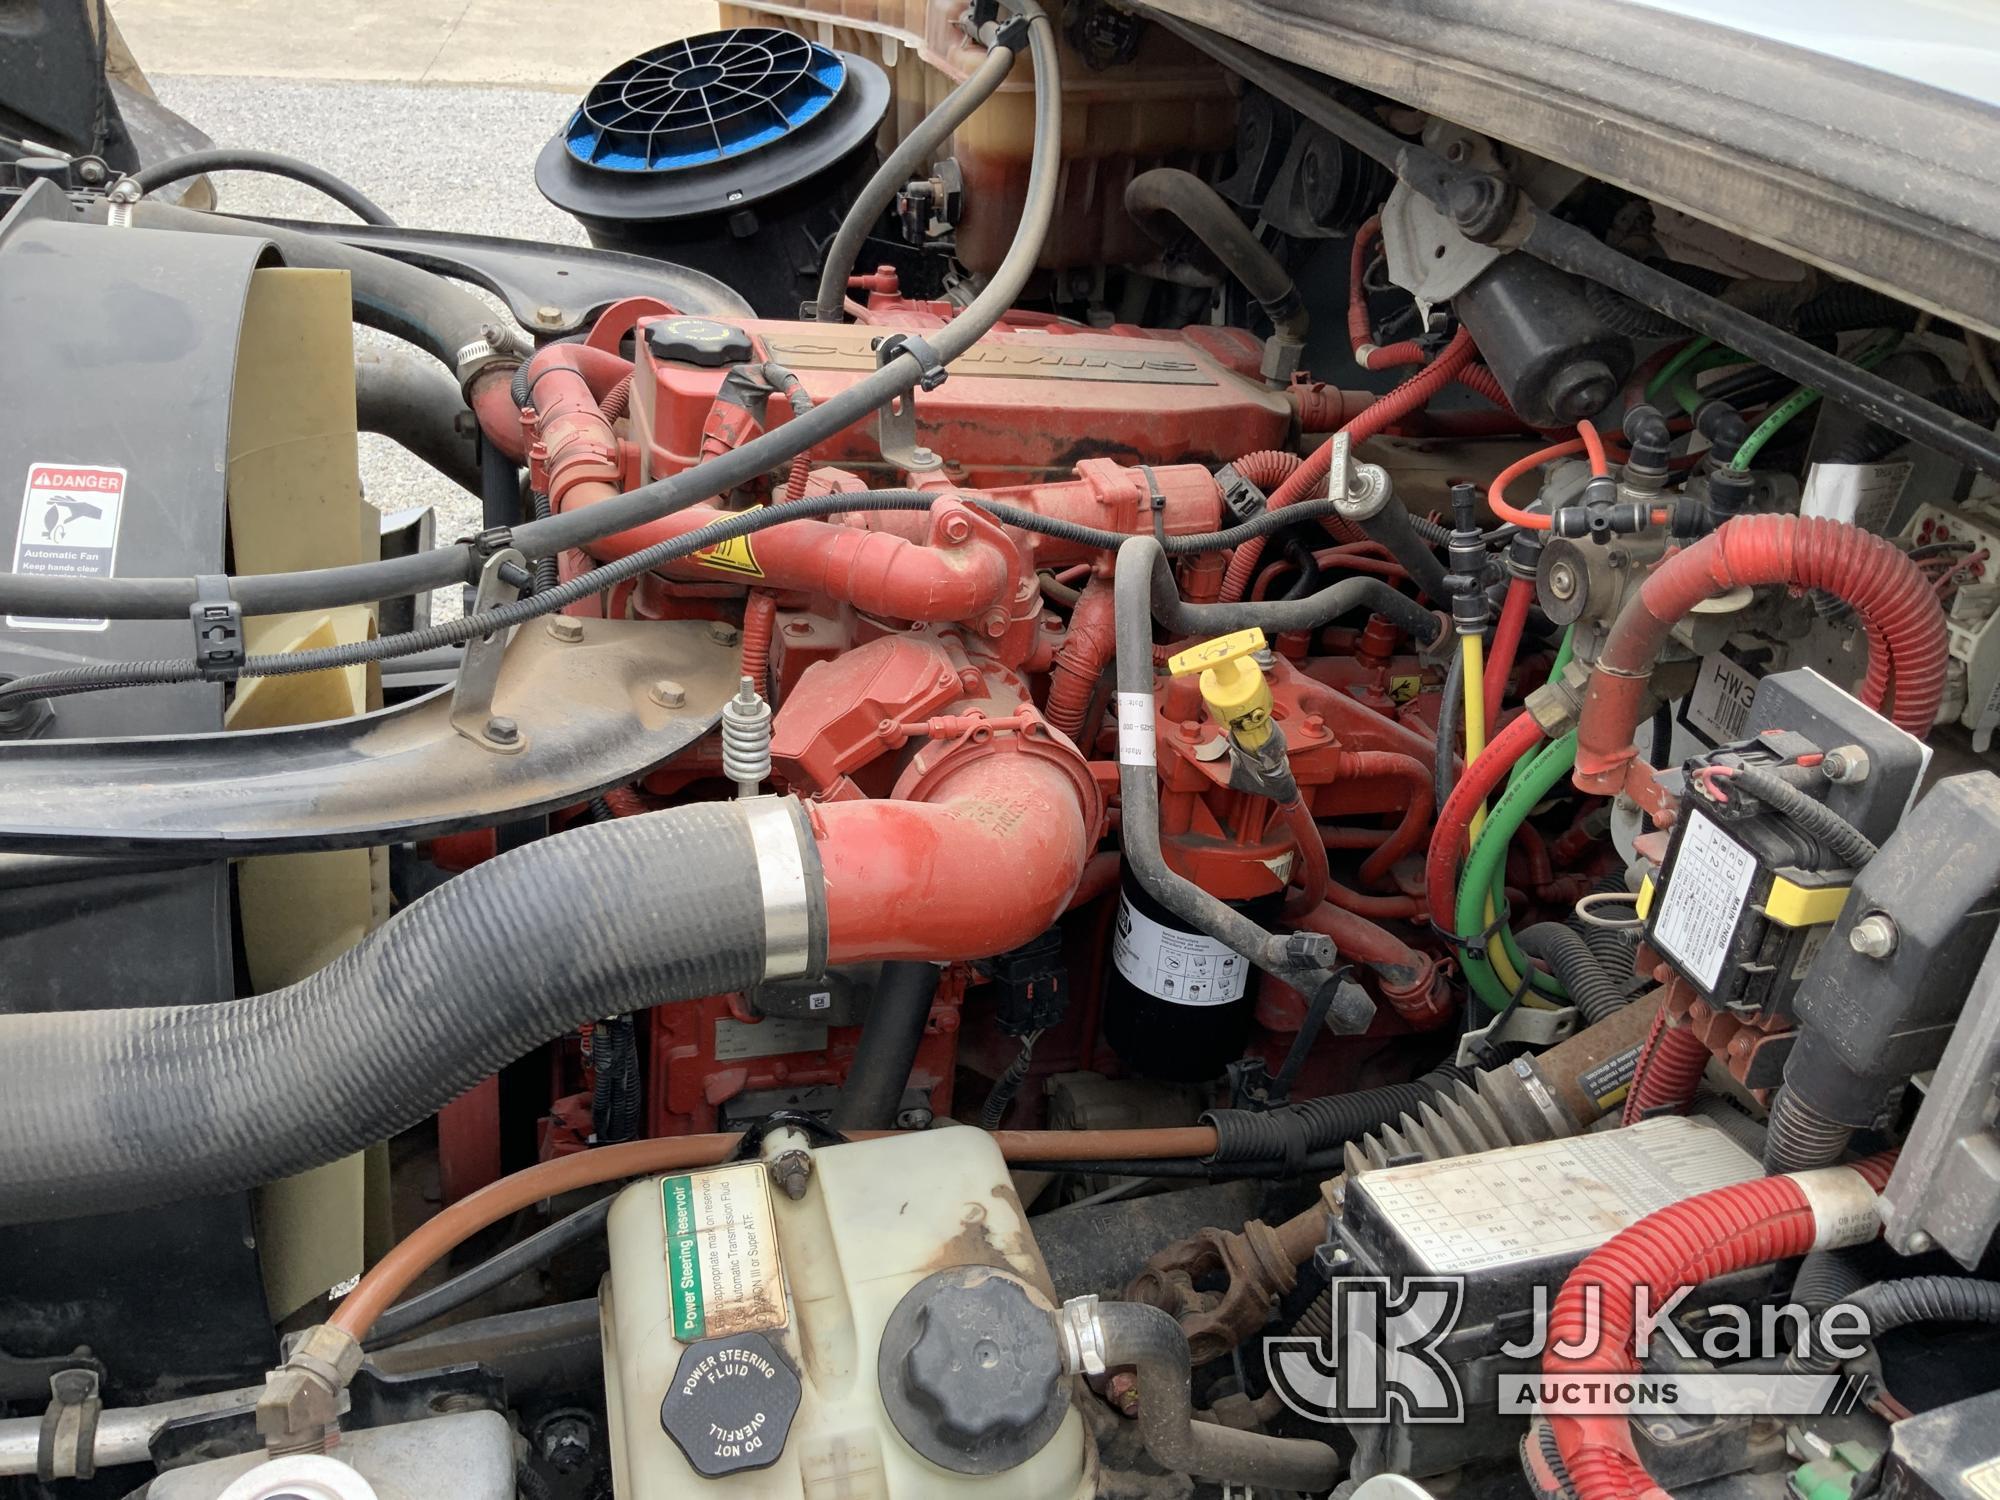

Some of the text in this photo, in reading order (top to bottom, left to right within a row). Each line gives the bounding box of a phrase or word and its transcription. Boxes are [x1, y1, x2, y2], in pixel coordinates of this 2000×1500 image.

[772, 344, 1198, 372] CUMINS
[52, 474, 120, 490] DANGER
[24, 550, 99, 561] Automatic Fan
[22, 562, 99, 573] Keep hands clear
[1710, 856, 1719, 868] 2
[1726, 870, 1735, 881] 3
[1720, 896, 1740, 949] MAIN PNDB
[719, 1181, 731, 1201] Fluid
[706, 1214, 714, 1225] on
[721, 1202, 738, 1258] Transmission
[745, 1231, 760, 1256] Super
[674, 1186, 696, 1330] Power Steering Reservoir
[750, 1258, 759, 1267] or
[707, 1250, 724, 1301] appropriate
[728, 1259, 744, 1304] Automatic
[750, 1268, 760, 1278] III
[683, 1349, 776, 1396] POWER STEERING
[707, 1364, 748, 1384] FLUID
[708, 1412, 766, 1442] OVERFILL
[714, 1436, 763, 1457] DO NOT
